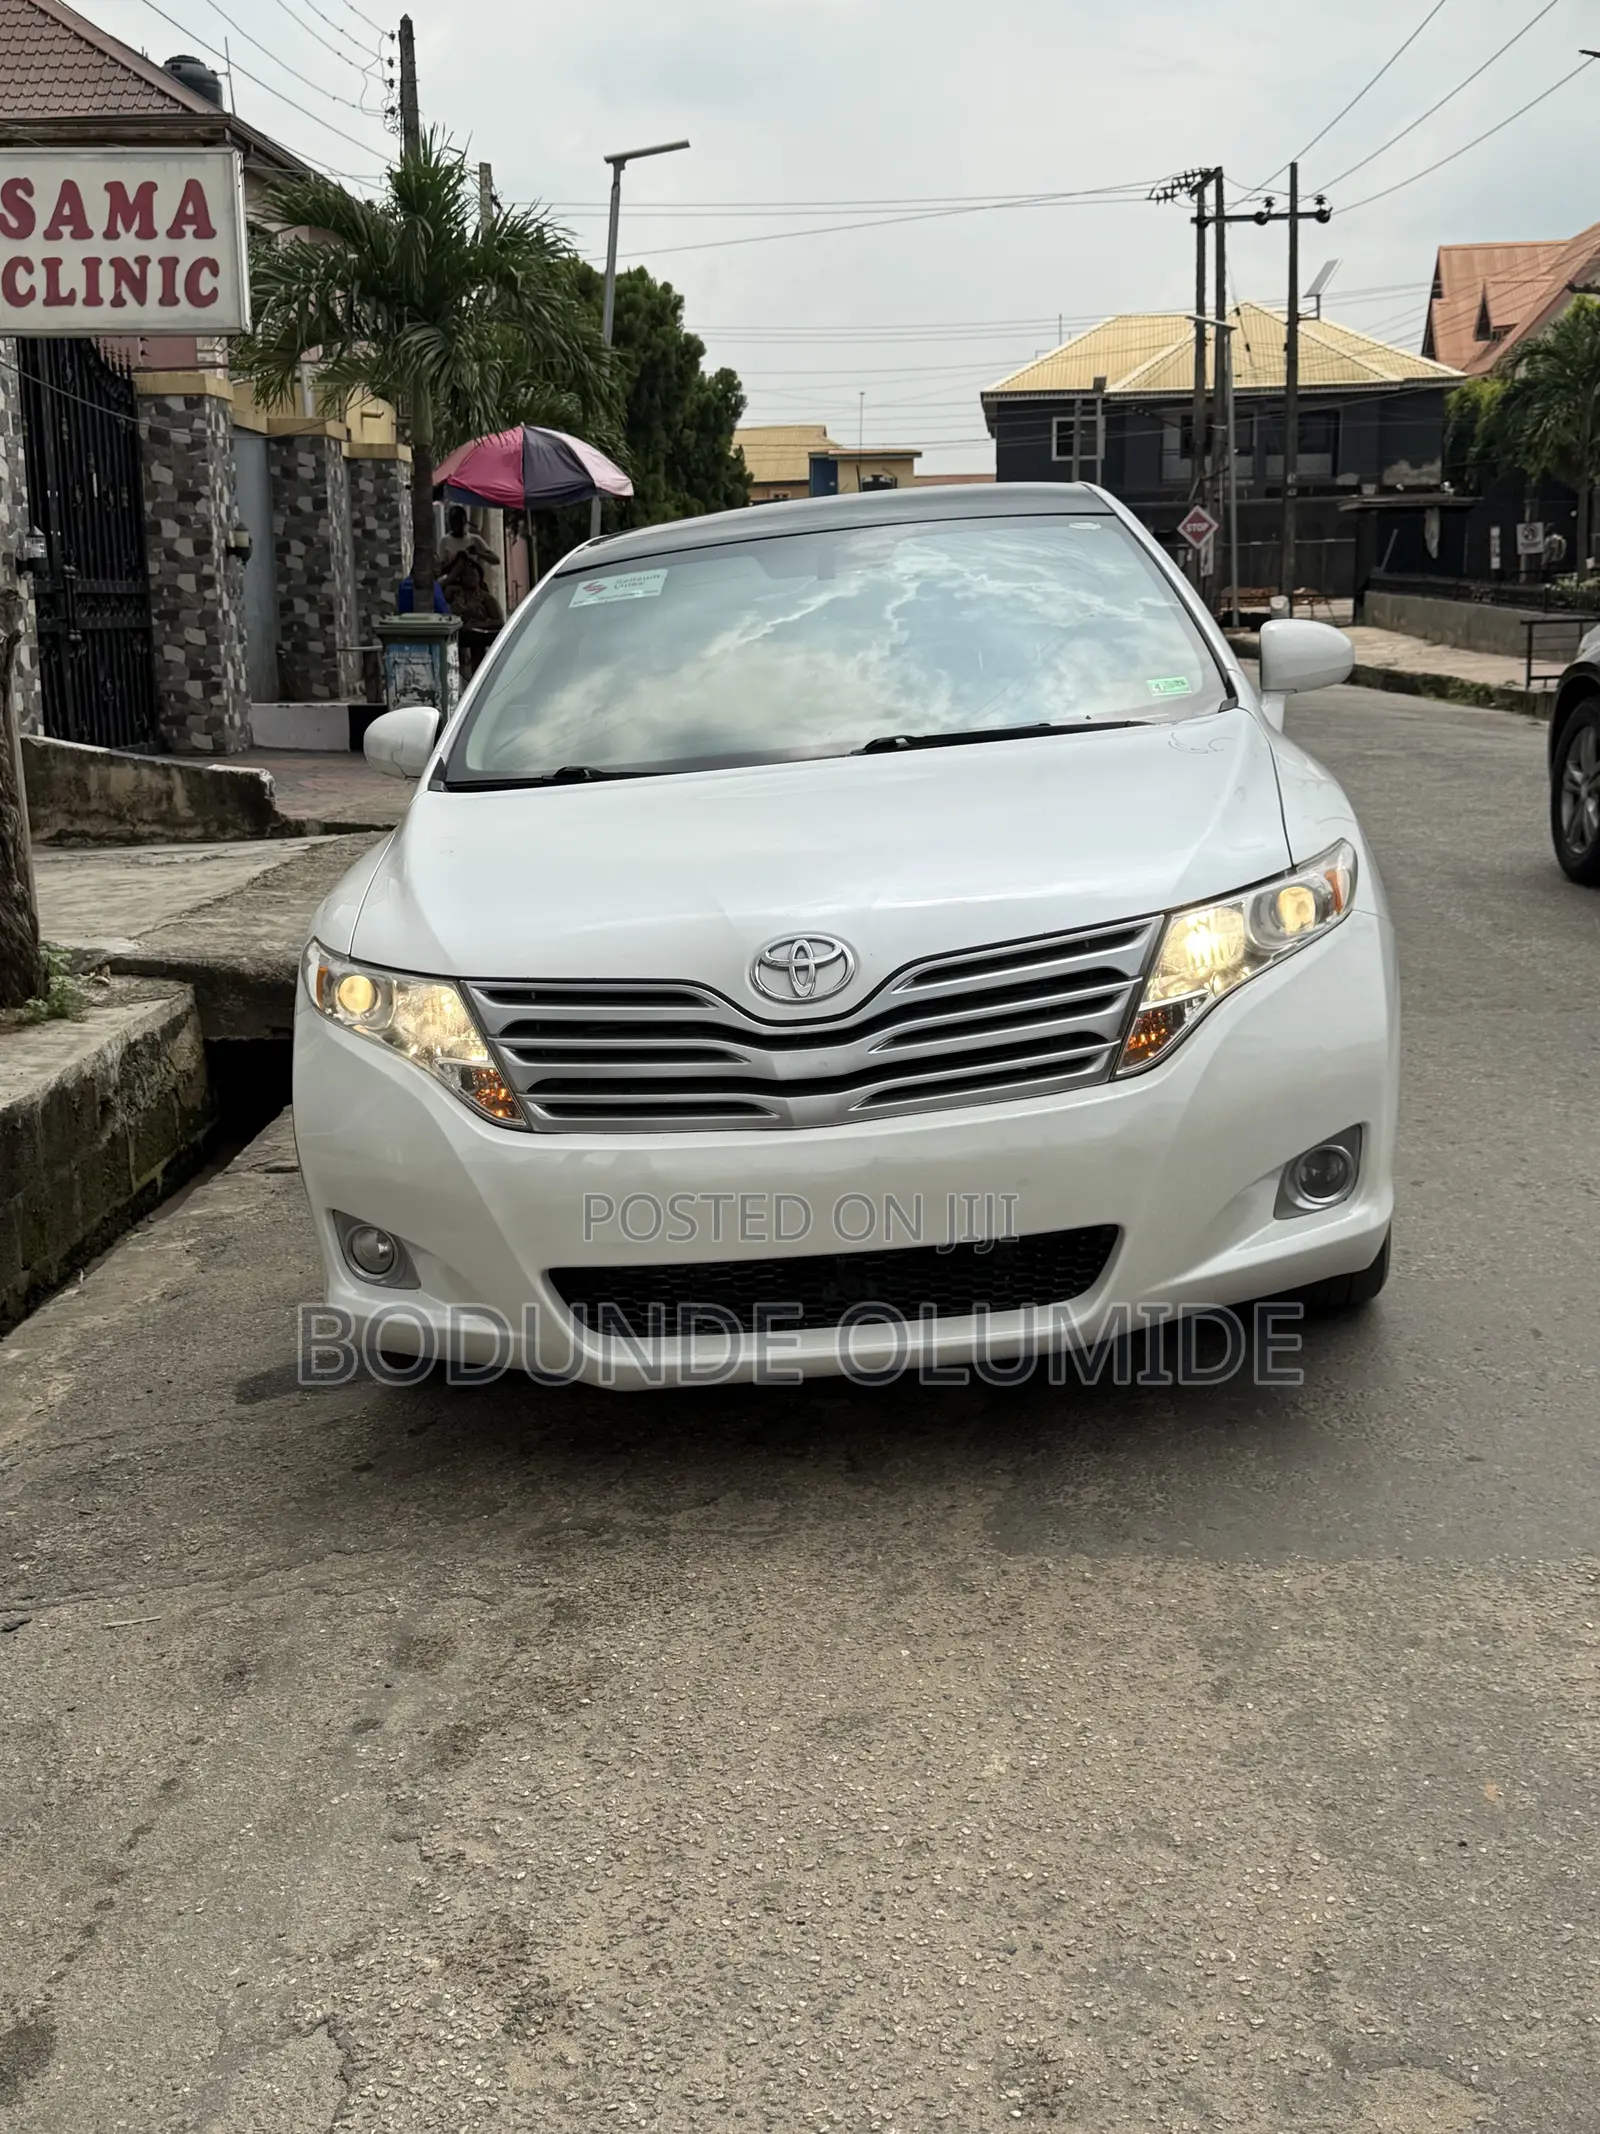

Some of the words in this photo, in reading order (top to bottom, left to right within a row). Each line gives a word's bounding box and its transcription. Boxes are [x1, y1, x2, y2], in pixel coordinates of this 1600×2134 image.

[0, 177, 217, 241] SAMA
[1, 255, 220, 308] CLINIC
[1186, 522, 1210, 532] STOP
